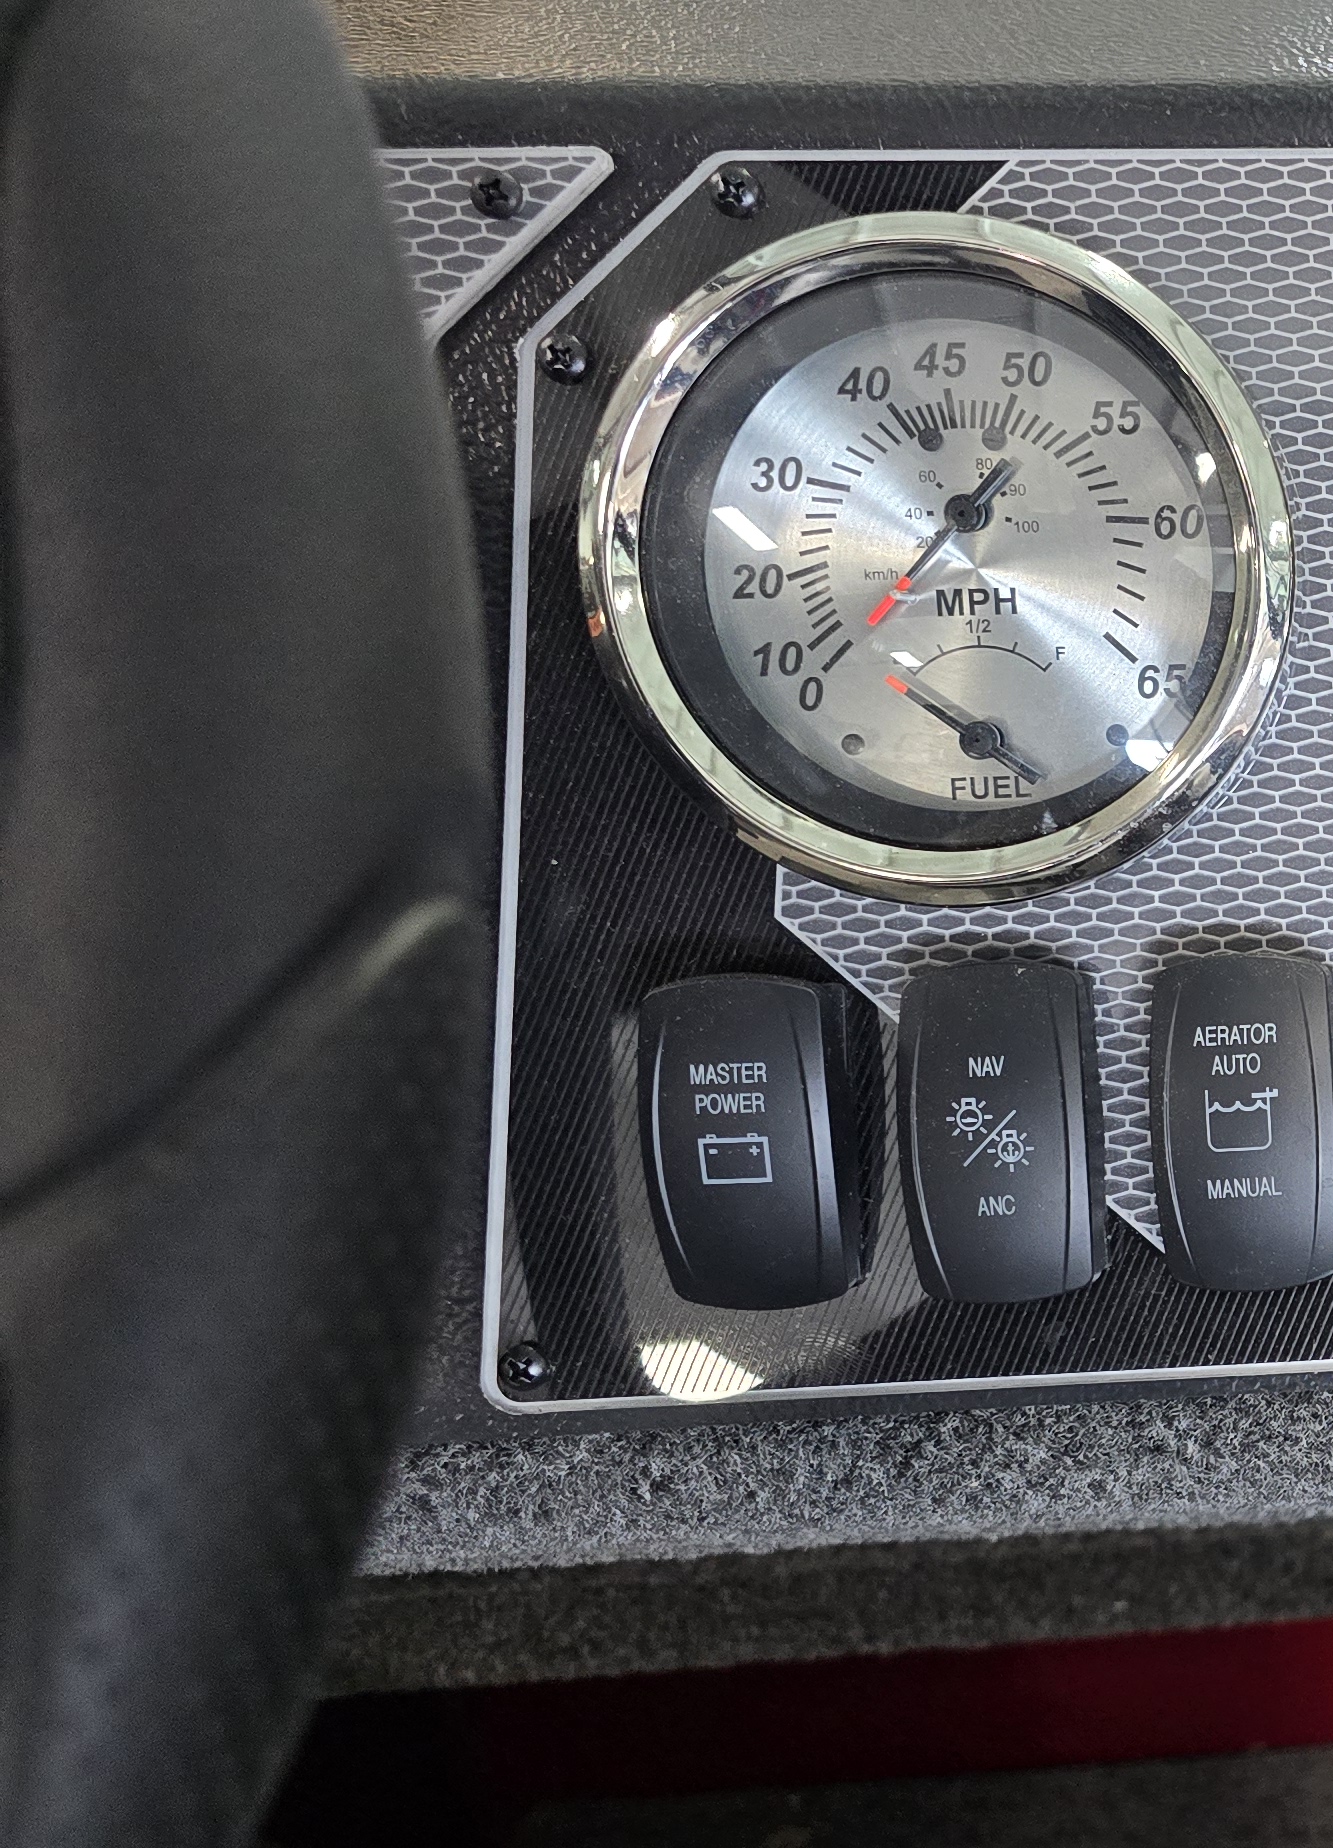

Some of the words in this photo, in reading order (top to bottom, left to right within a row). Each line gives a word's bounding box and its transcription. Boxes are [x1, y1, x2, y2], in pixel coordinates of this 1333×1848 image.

[914, 343, 967, 377] 45
[1002, 351, 1052, 385] 50
[838, 366, 890, 401] 40
[1091, 401, 1140, 434] 55
[751, 458, 802, 492] 30
[976, 458, 993, 470] 80
[918, 470, 936, 483] 60
[1009, 484, 1026, 496] 90
[905, 508, 922, 519] 40
[1154, 505, 1203, 539] 60
[1014, 521, 1039, 533] 100
[733, 565, 783, 599] 20
[864, 568, 898, 580] km/h
[936, 588, 1017, 616] MPH
[965, 619, 991, 633] 1/2
[752, 643, 802, 676] 10
[1055, 646, 1065, 660] F
[1137, 665, 1187, 698] 65
[800, 677, 822, 711] 0
[951, 776, 1032, 800] FUEL
[1194, 1023, 1277, 1047] AERATOR
[689, 1063, 767, 1085] MASTER
[968, 1055, 1004, 1077] NAV
[1211, 1054, 1261, 1075] AUTO
[695, 1093, 765, 1114] POWER
[1207, 1177, 1282, 1200] MANUAL
[978, 1195, 1016, 1216] ANC
